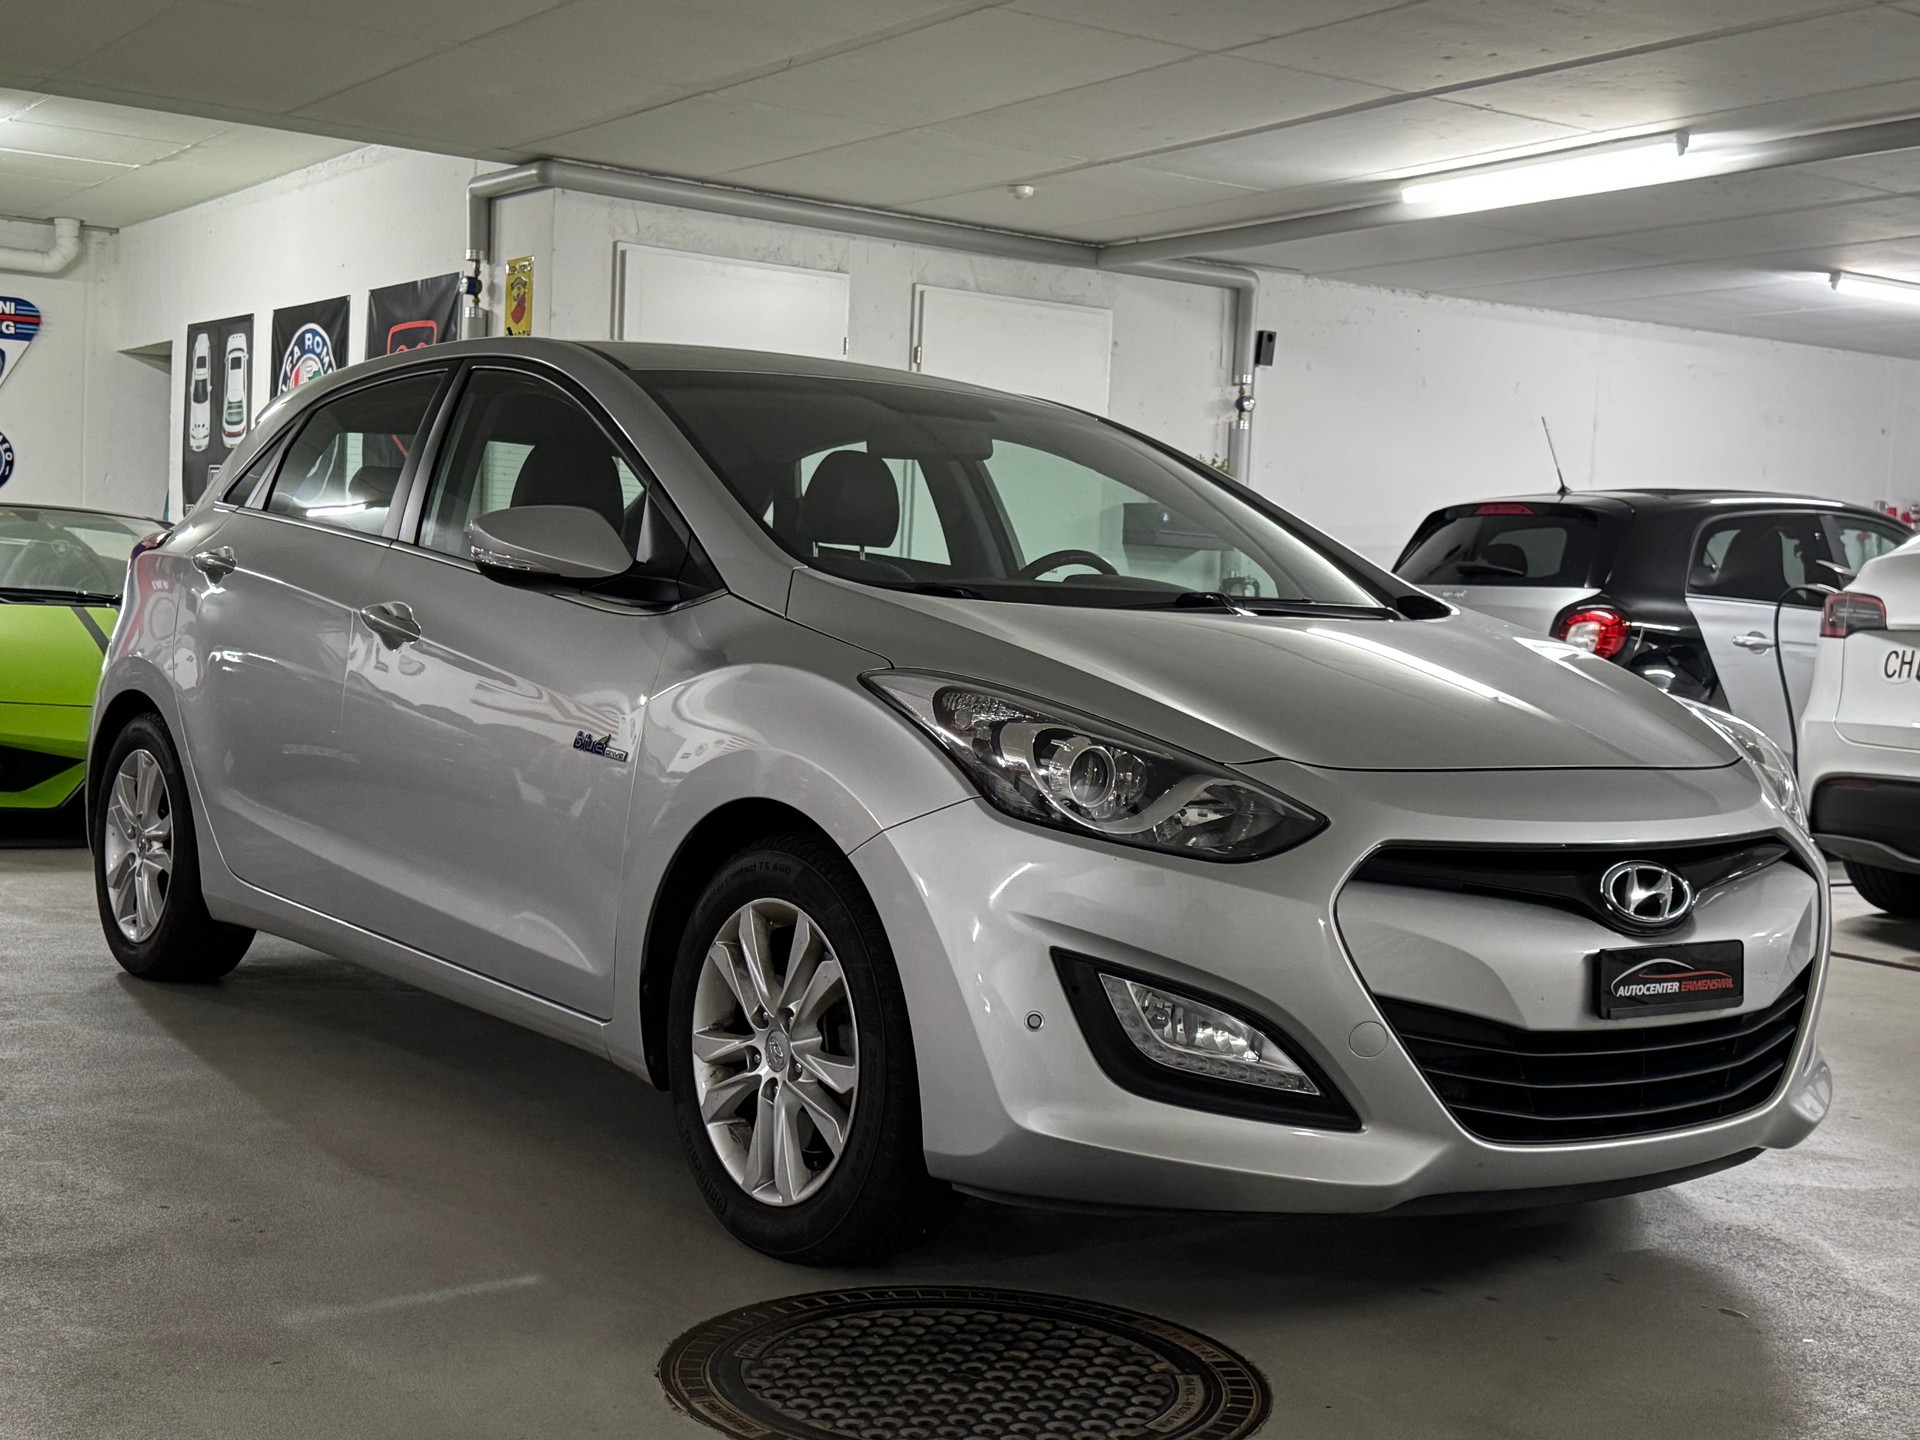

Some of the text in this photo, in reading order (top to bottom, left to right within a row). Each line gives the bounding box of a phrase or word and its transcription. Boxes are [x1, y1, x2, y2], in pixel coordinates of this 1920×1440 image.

[281, 332, 333, 393] LFA ROM
[1884, 650, 1916, 679] CH
[758, 861, 770, 871] TS
[1616, 982, 1680, 997] AUTOCENTER
